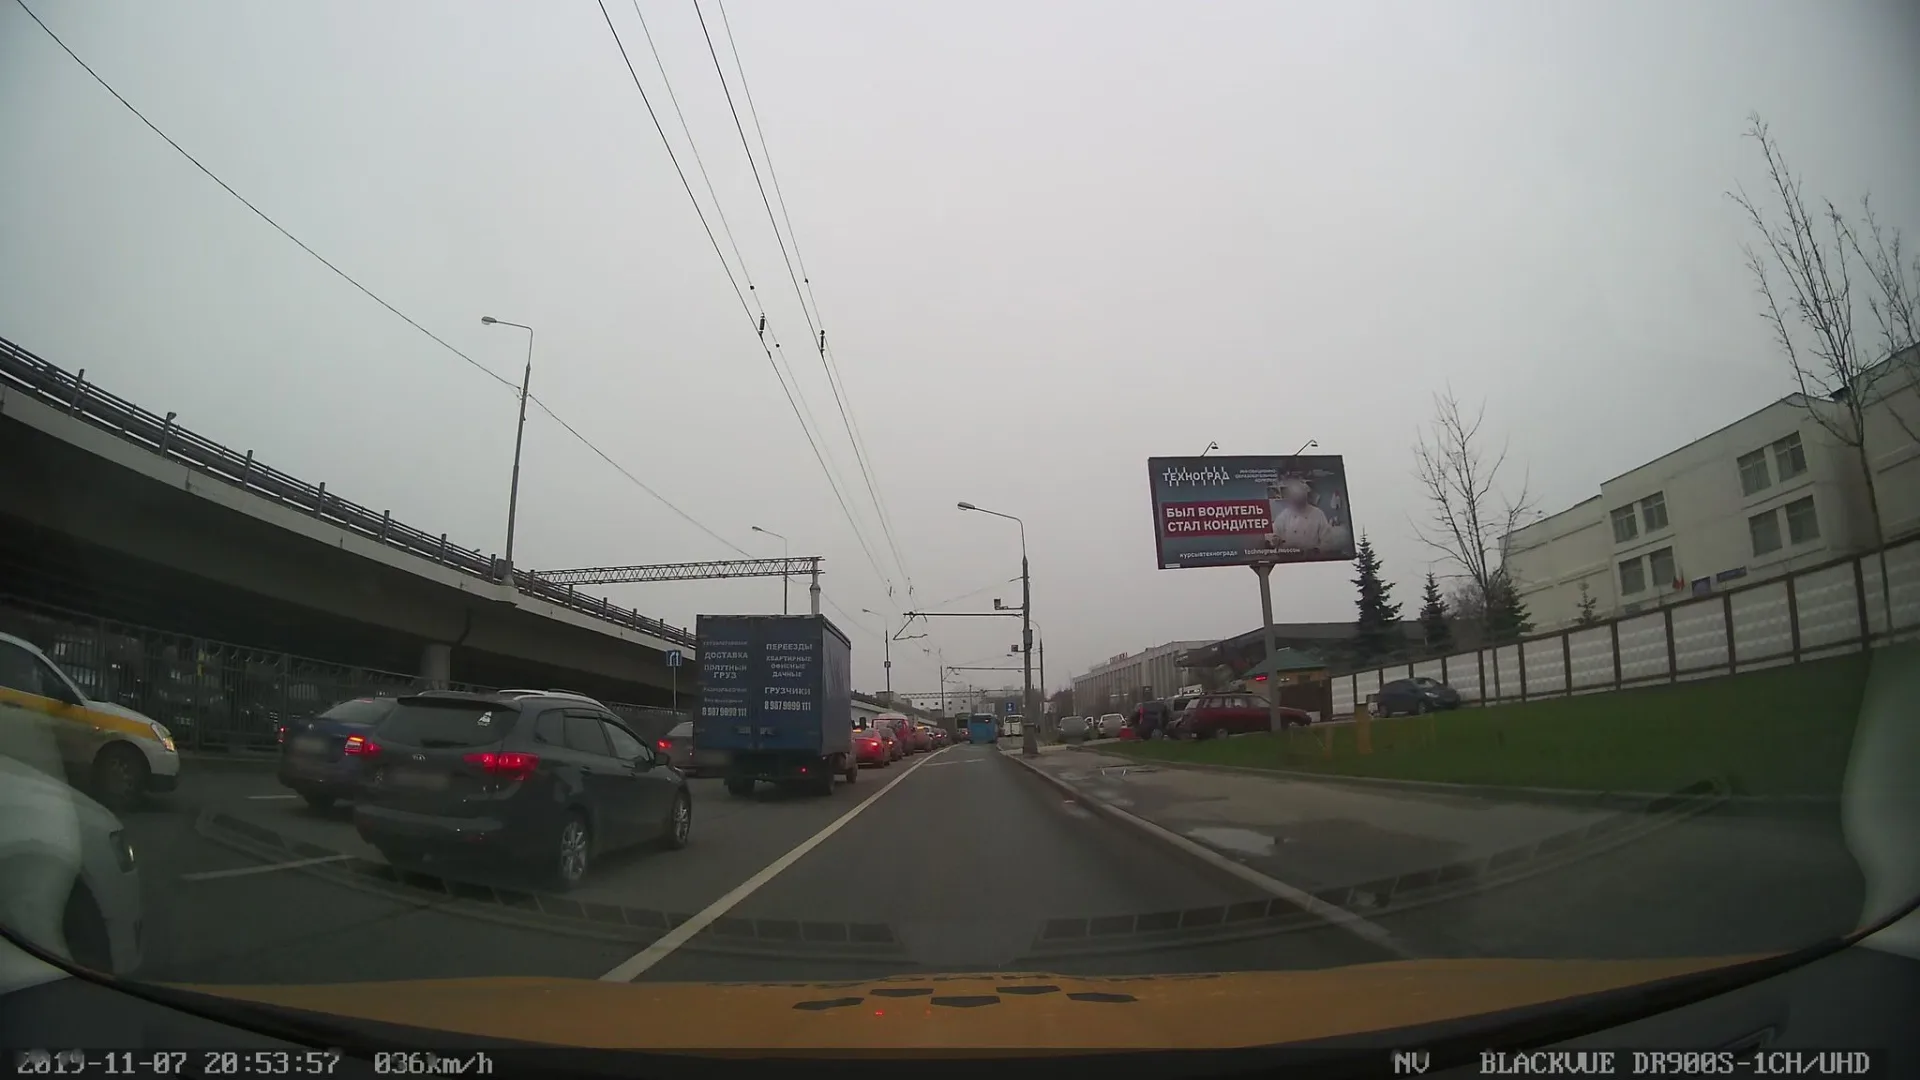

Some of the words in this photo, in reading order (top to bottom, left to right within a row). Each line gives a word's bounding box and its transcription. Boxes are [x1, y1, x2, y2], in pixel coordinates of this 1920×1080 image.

[1163, 466, 1230, 487] ТЕХНОГРАД
[1166, 507, 1195, 518] БЫЛ
[1198, 505, 1264, 518] ВОДИТЕЛЬ
[1167, 521, 1200, 532] СТАЛ
[1203, 519, 1269, 531] КОНДИТЕР
[766, 643, 812, 651] ПЕРЕЕЗДЫ
[704, 651, 748, 660] ДОСТАВКА
[713, 671, 737, 679] ГРУЗ
[764, 687, 811, 695] ГРУЗЧИКИ
